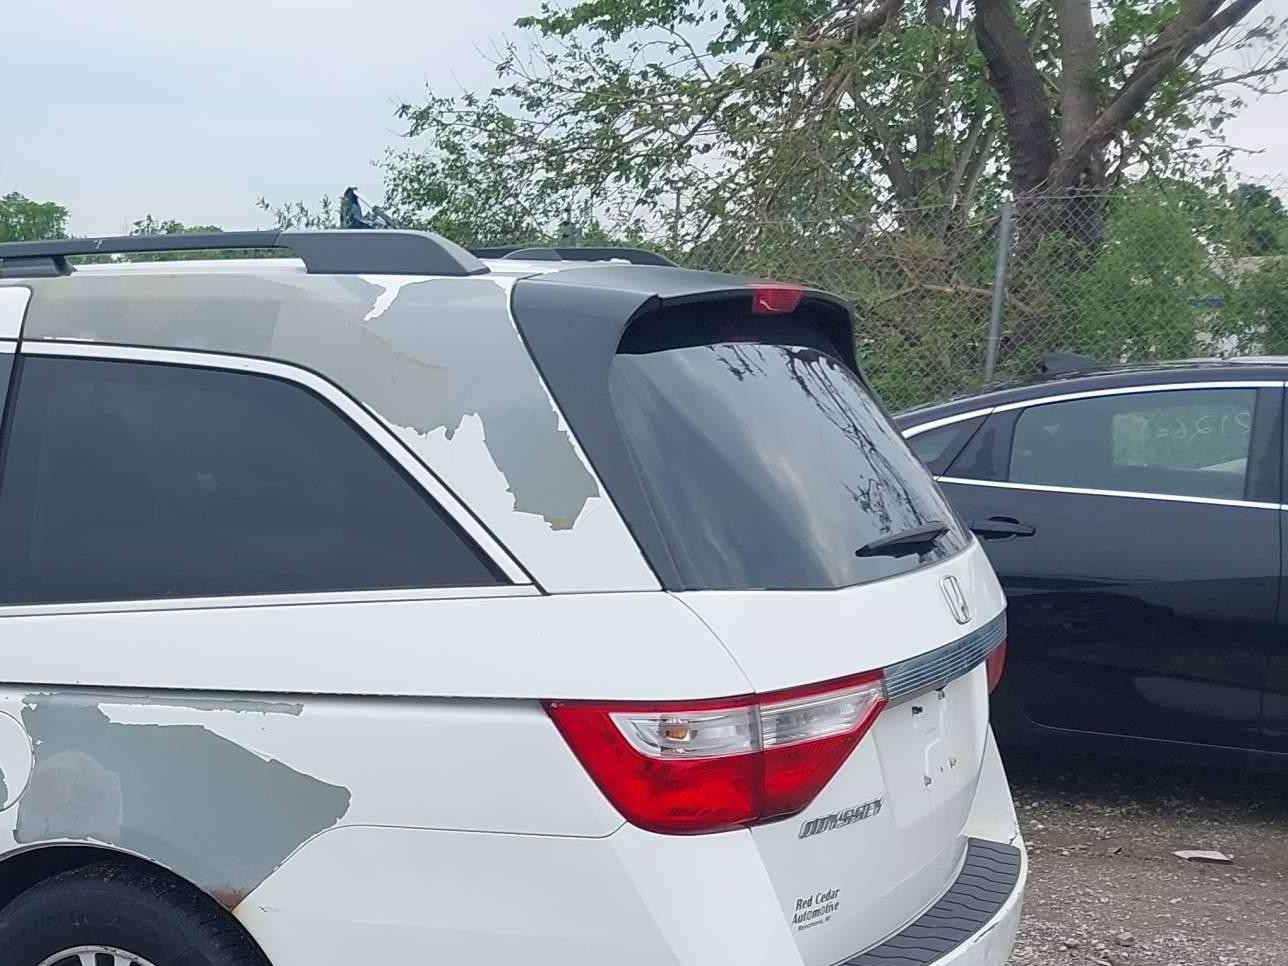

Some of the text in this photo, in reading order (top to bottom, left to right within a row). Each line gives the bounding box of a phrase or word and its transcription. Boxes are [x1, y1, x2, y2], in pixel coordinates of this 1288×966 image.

[795, 888, 840, 911] Red Cedar
[792, 901, 840, 924] Automotive
